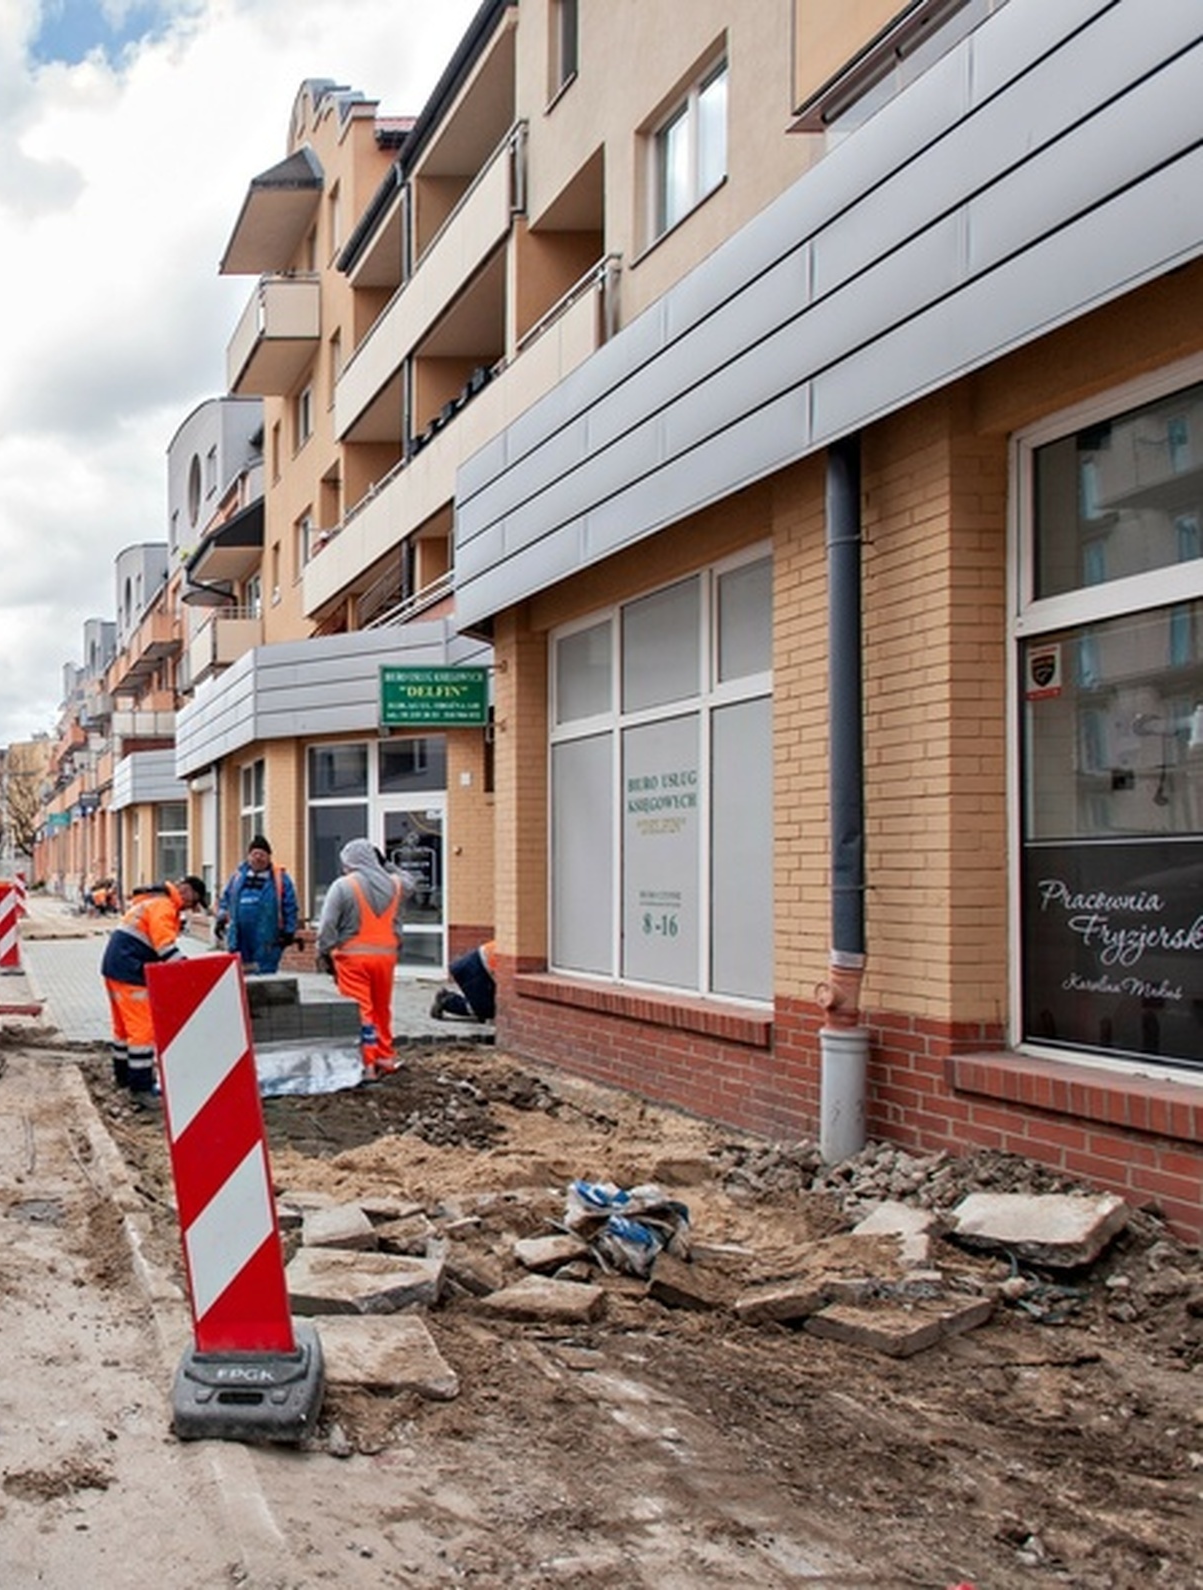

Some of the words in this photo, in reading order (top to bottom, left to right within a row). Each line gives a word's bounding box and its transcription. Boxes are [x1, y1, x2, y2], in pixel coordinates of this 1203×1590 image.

[399, 685, 468, 698] "DELFIN"
[628, 776, 658, 793] BIURO
[661, 770, 697, 788] USŁUG
[628, 793, 697, 813] KSIĘGOWYCH
[1038, 879, 1165, 911] Pracownia
